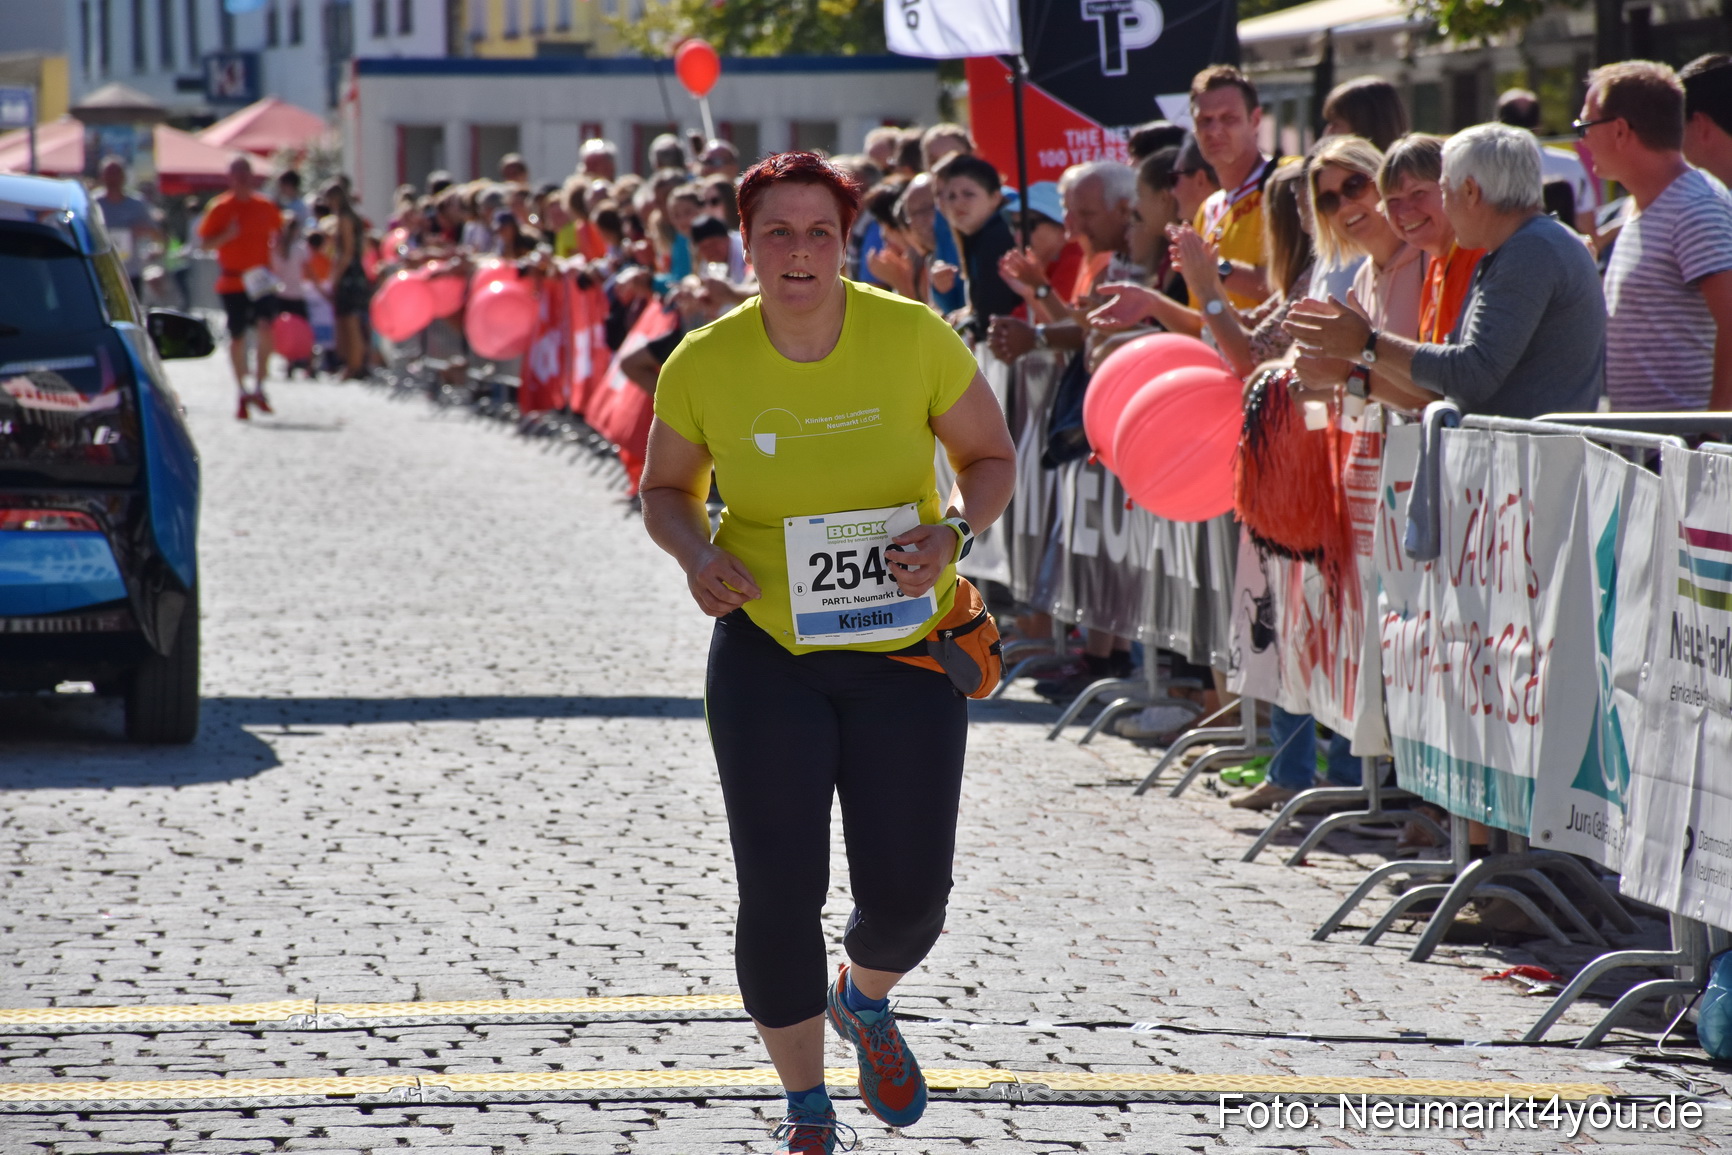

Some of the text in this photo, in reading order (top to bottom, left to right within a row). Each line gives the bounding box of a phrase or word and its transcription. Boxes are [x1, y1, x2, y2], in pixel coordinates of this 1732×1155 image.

[1063, 128, 1099, 148] THE
[1037, 148, 1067, 167] 100
[805, 416, 832, 424] Kliniken
[847, 408, 879, 418] Landkreises
[827, 419, 858, 429] Neumarkt
[827, 521, 887, 539] BOCK
[797, 584, 803, 593] B
[822, 595, 852, 606] PARTL
[854, 592, 894, 603] Neumarkt
[838, 610, 893, 629] Kristin
[1566, 804, 1591, 835] Jura
